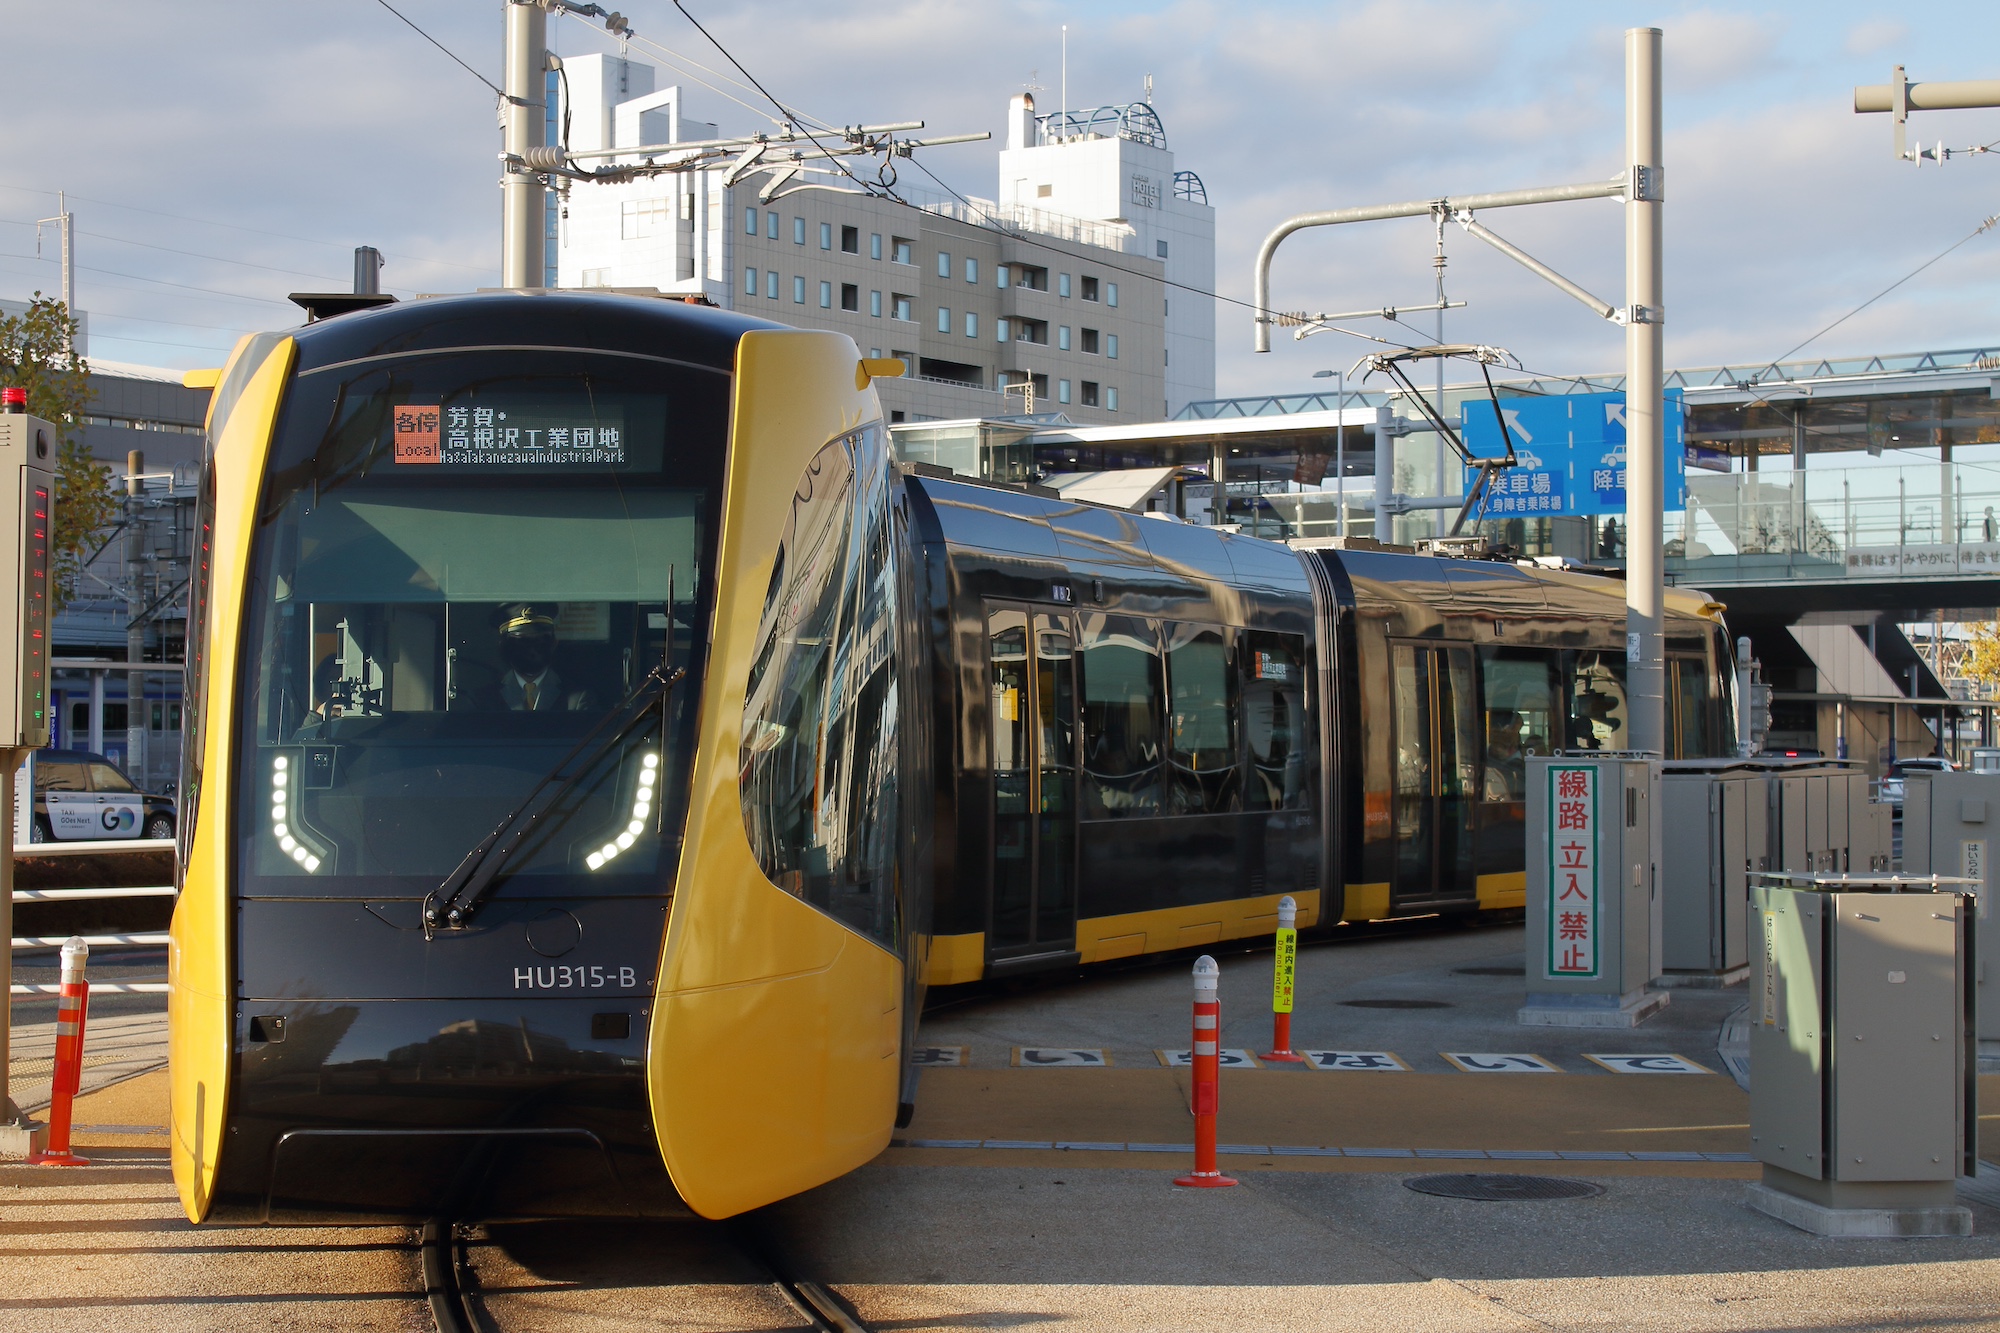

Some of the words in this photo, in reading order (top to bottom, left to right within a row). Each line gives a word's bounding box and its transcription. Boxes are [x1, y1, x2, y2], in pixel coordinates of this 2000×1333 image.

[1132, 181, 1160, 198] HOTEL
[1132, 193, 1153, 208] METS
[396, 413, 438, 433] 各停
[448, 428, 619, 449] 高根沢工業団地
[396, 443, 437, 456] Local
[1489, 473, 1551, 495] 乗車場
[1493, 495, 1562, 512] 身障者乗降場
[1066, 587, 1071, 601] 2
[1558, 770, 1588, 971] 線路立入禁止
[514, 966, 636, 989] HU315-B
